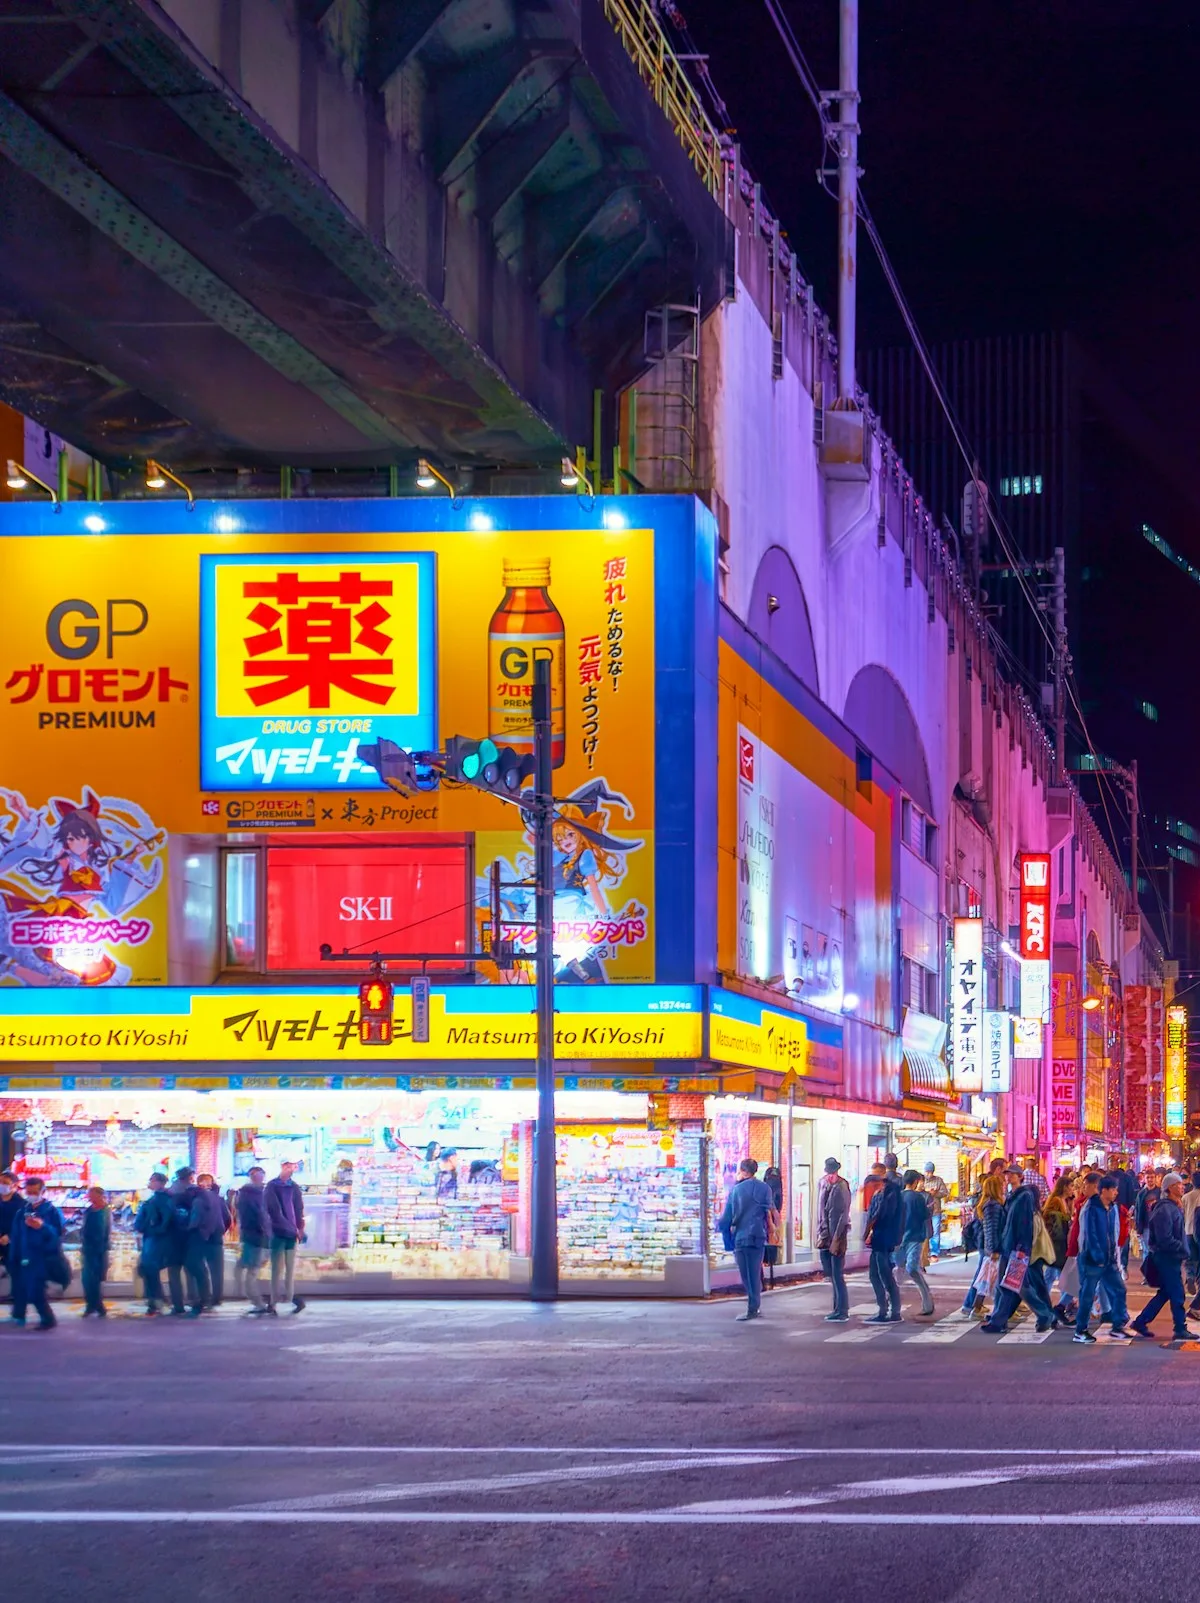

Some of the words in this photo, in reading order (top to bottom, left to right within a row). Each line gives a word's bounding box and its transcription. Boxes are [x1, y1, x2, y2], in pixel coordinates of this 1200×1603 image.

[46, 598, 149, 660] GP
[243, 572, 396, 709] 薬
[5, 664, 189, 704] グロモント
[503, 699, 534, 707] PREM
[38, 711, 156, 729] PREMIUM
[262, 719, 312, 735] DRUG
[316, 719, 373, 734] STORE
[226, 801, 255, 818] GP
[256, 810, 302, 818] PREMIUM
[339, 897, 393, 920] SK-II
[13, 920, 149, 944] コラボキャンペーン
[503, 920, 645, 945] アクルスタンド
[1026, 902, 1044, 953] KFC
[0, 1032, 102, 1047] atsumoto
[106, 1029, 189, 1046] KiYoshi
[223, 1010, 413, 1051] マツモトキシ
[446, 1028, 577, 1044] Matsumto
[582, 1027, 665, 1044] KiYoshi
[1052, 1063, 1076, 1077] DVD
[1052, 1107, 1075, 1122] obby
